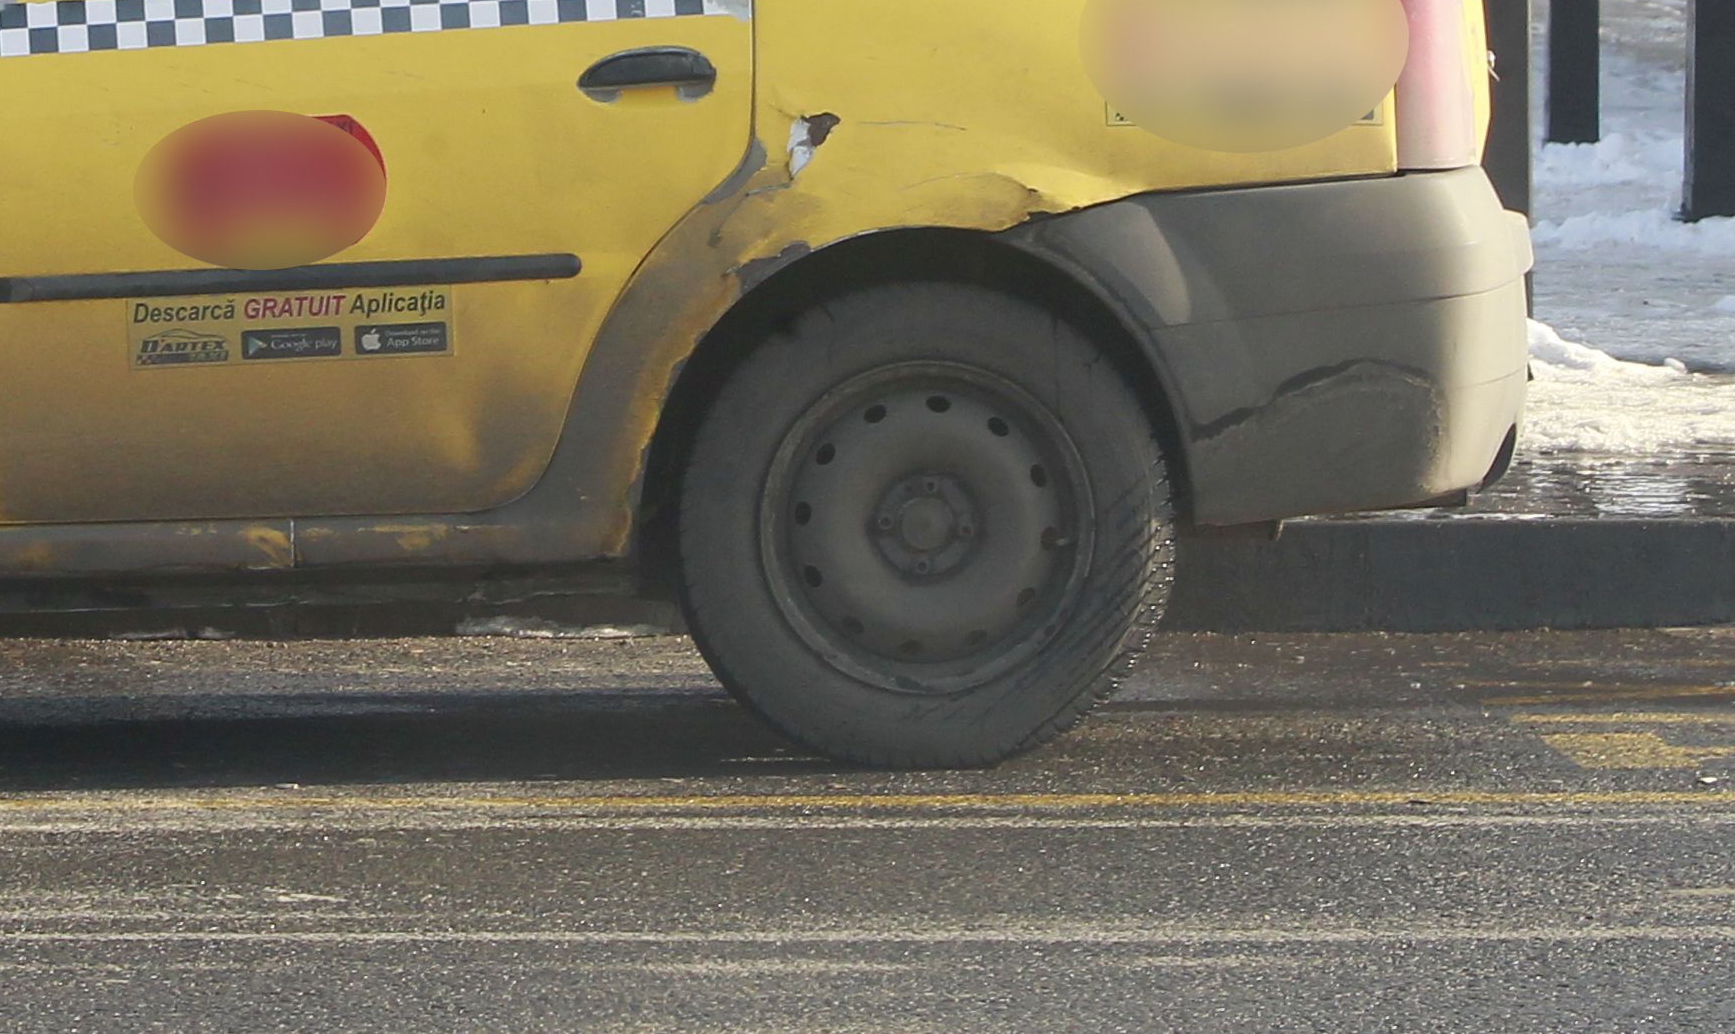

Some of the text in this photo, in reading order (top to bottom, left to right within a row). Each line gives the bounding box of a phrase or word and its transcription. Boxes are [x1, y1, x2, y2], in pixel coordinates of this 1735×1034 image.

[133, 300, 235, 323] Descarcă
[244, 295, 346, 319] GRATUIT
[270, 337, 338, 352] Google play
[386, 335, 440, 349] App Store
